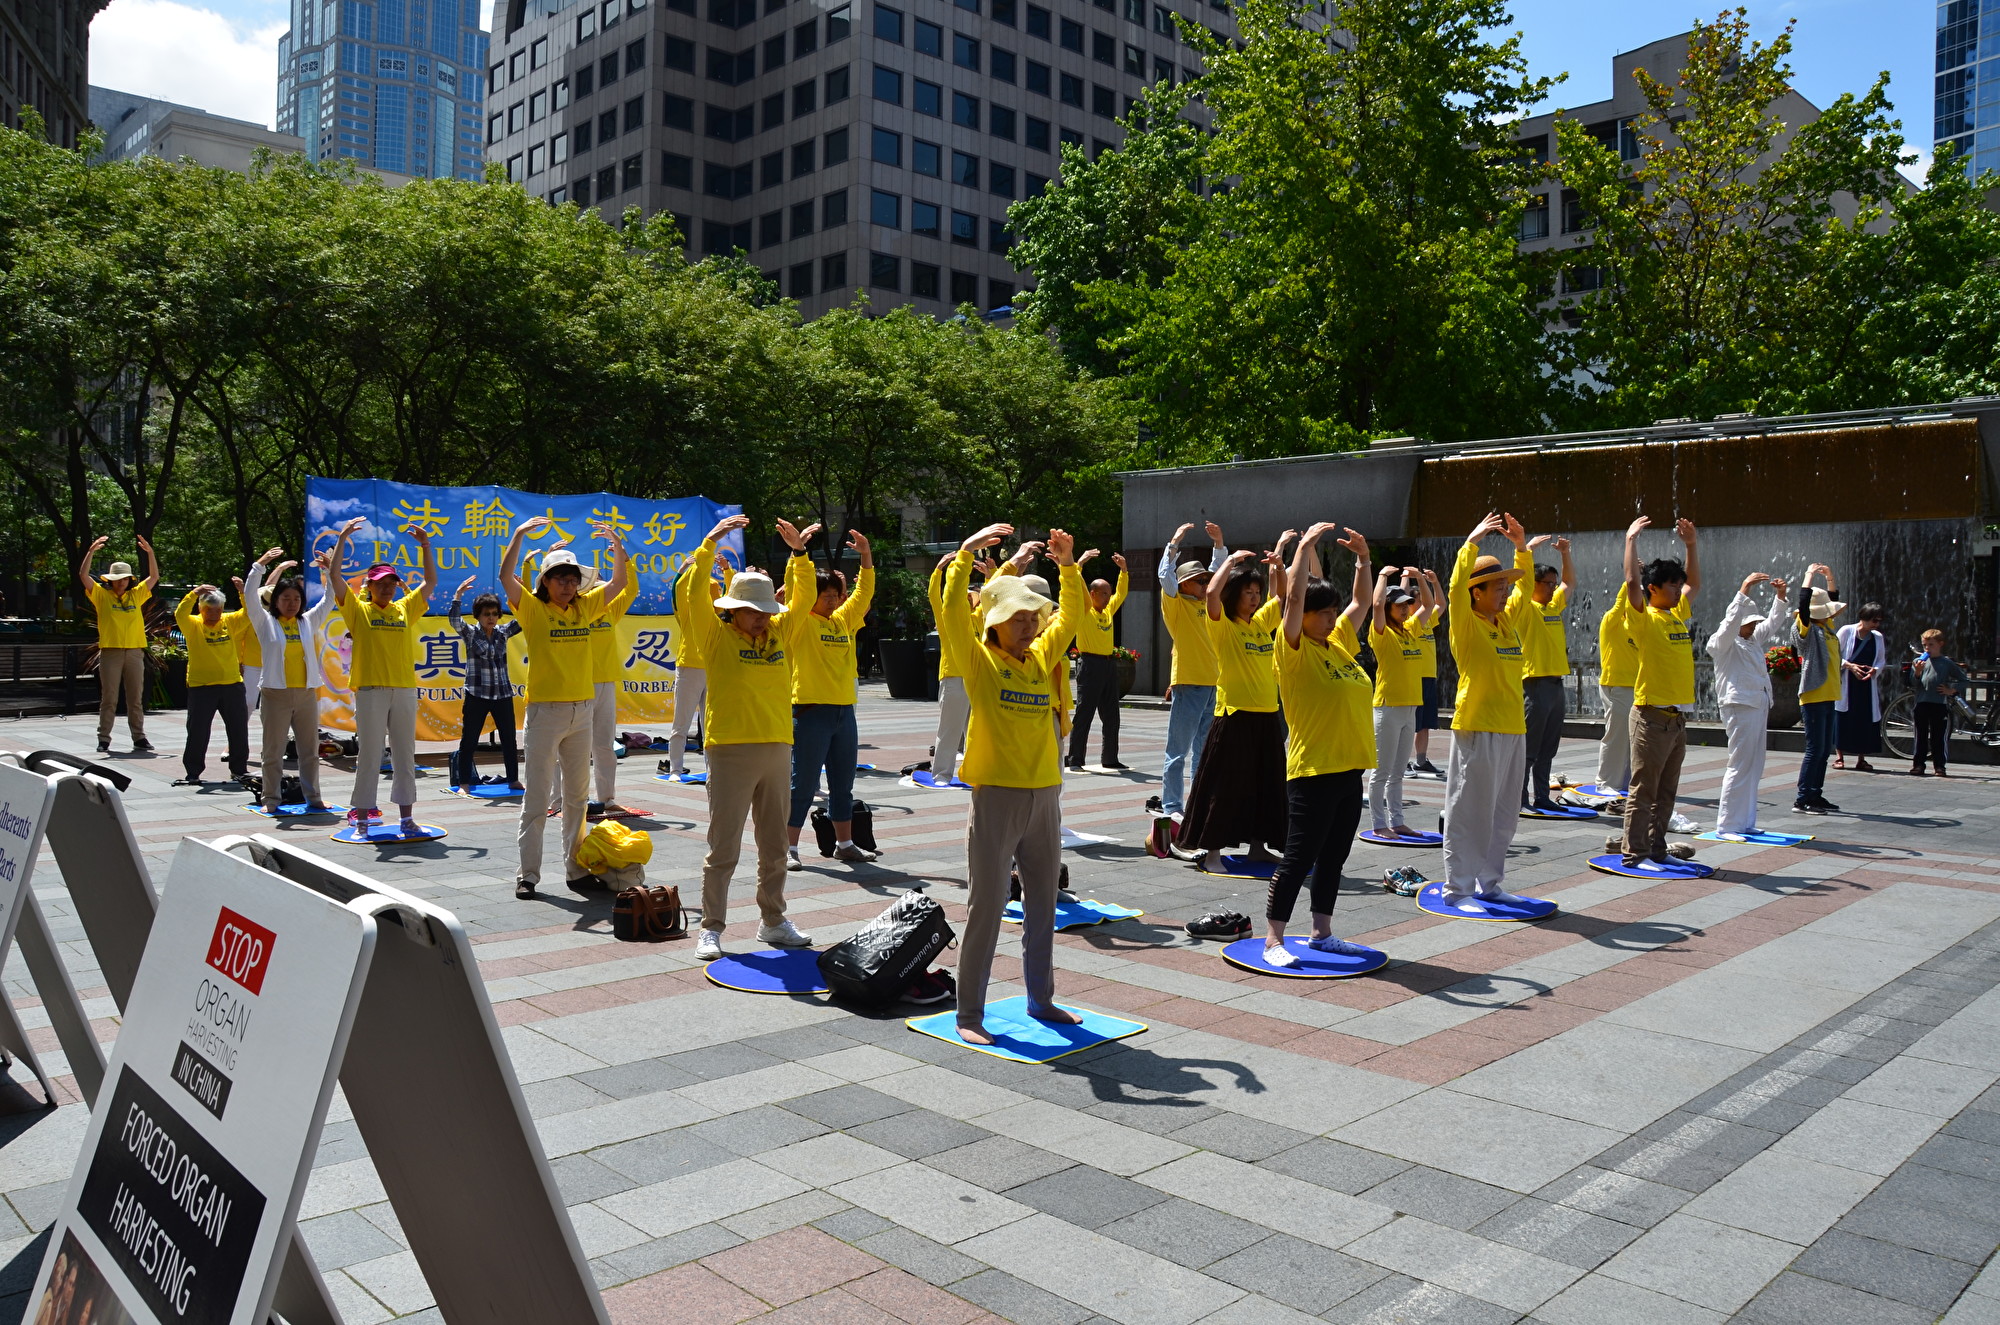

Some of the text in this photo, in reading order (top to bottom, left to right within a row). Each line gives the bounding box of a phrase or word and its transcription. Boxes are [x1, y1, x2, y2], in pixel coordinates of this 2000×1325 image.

[371, 540, 482, 570] FALUN
[631, 550, 693, 575] GOO
[625, 630, 676, 671] 忍
[1003, 691, 1035, 704] FALUN
[213, 922, 263, 983] STOP
[899, 942, 932, 977] lululemon
[195, 978, 252, 1043] ORGAN
[186, 1016, 239, 1071] HARVESTING
[178, 1052, 222, 1111] IN CHINA
[121, 1101, 232, 1248] FORCED ORGAN
[109, 1182, 197, 1317] HARVESTING
